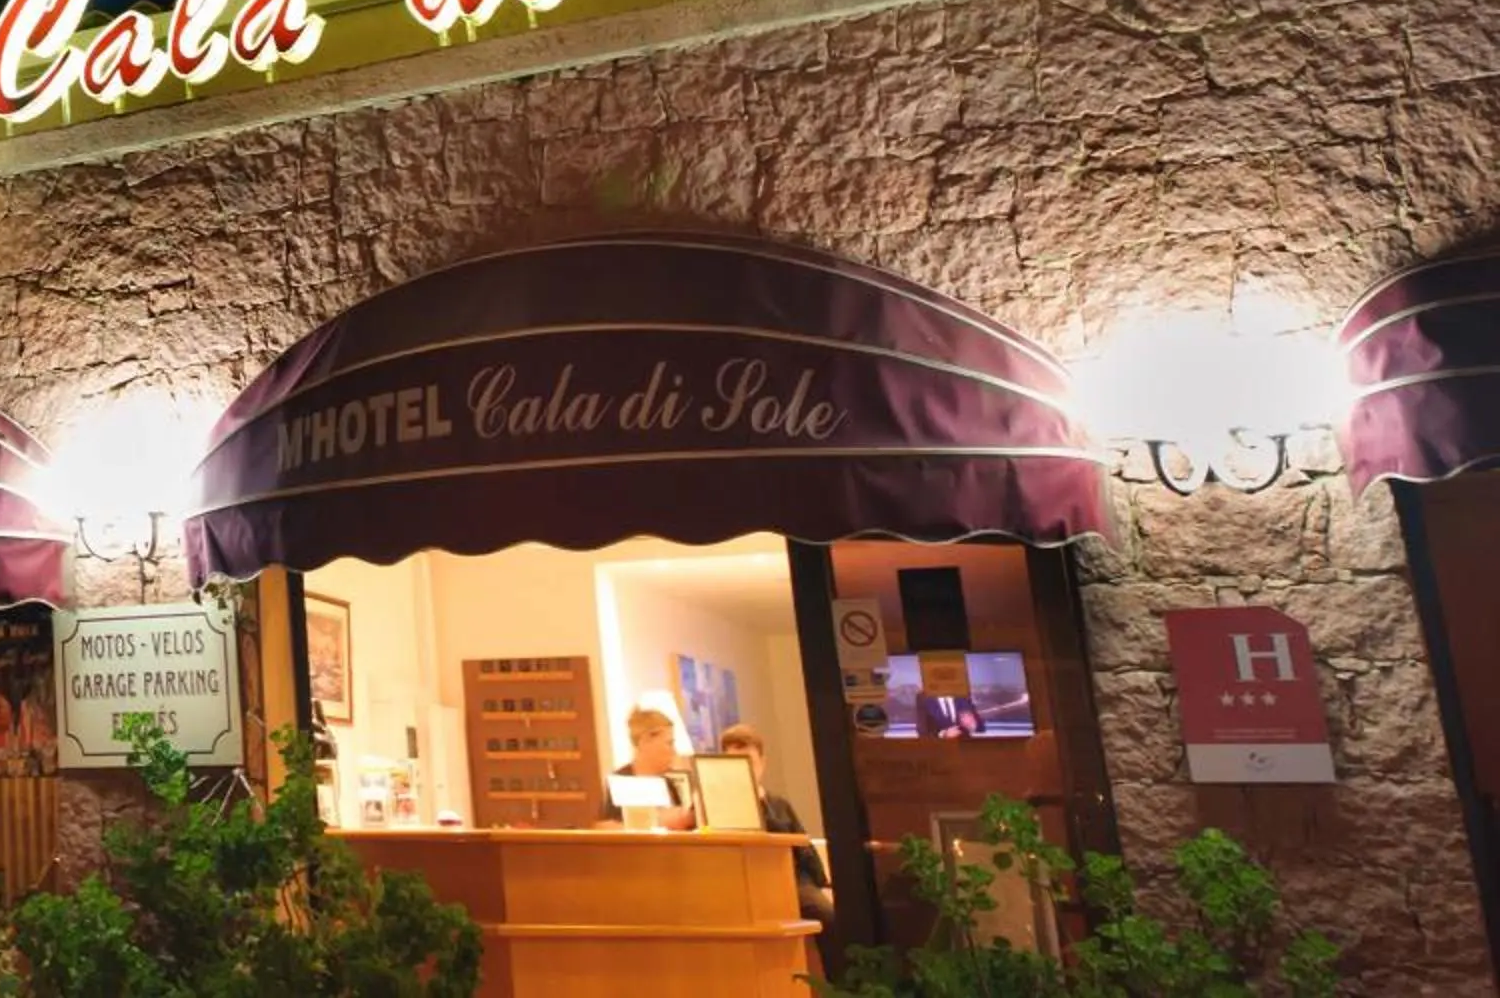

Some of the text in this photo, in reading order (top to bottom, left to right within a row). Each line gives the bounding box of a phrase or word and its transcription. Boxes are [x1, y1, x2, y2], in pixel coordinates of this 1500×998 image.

[466, 361, 606, 439] Cala
[617, 360, 691, 431] di
[702, 356, 849, 440] Sole
[81, 633, 136, 660] MOTOS
[151, 629, 206, 657] VELOS
[1229, 632, 1301, 682] H
[71, 669, 220, 699] GARAGE PARKING
